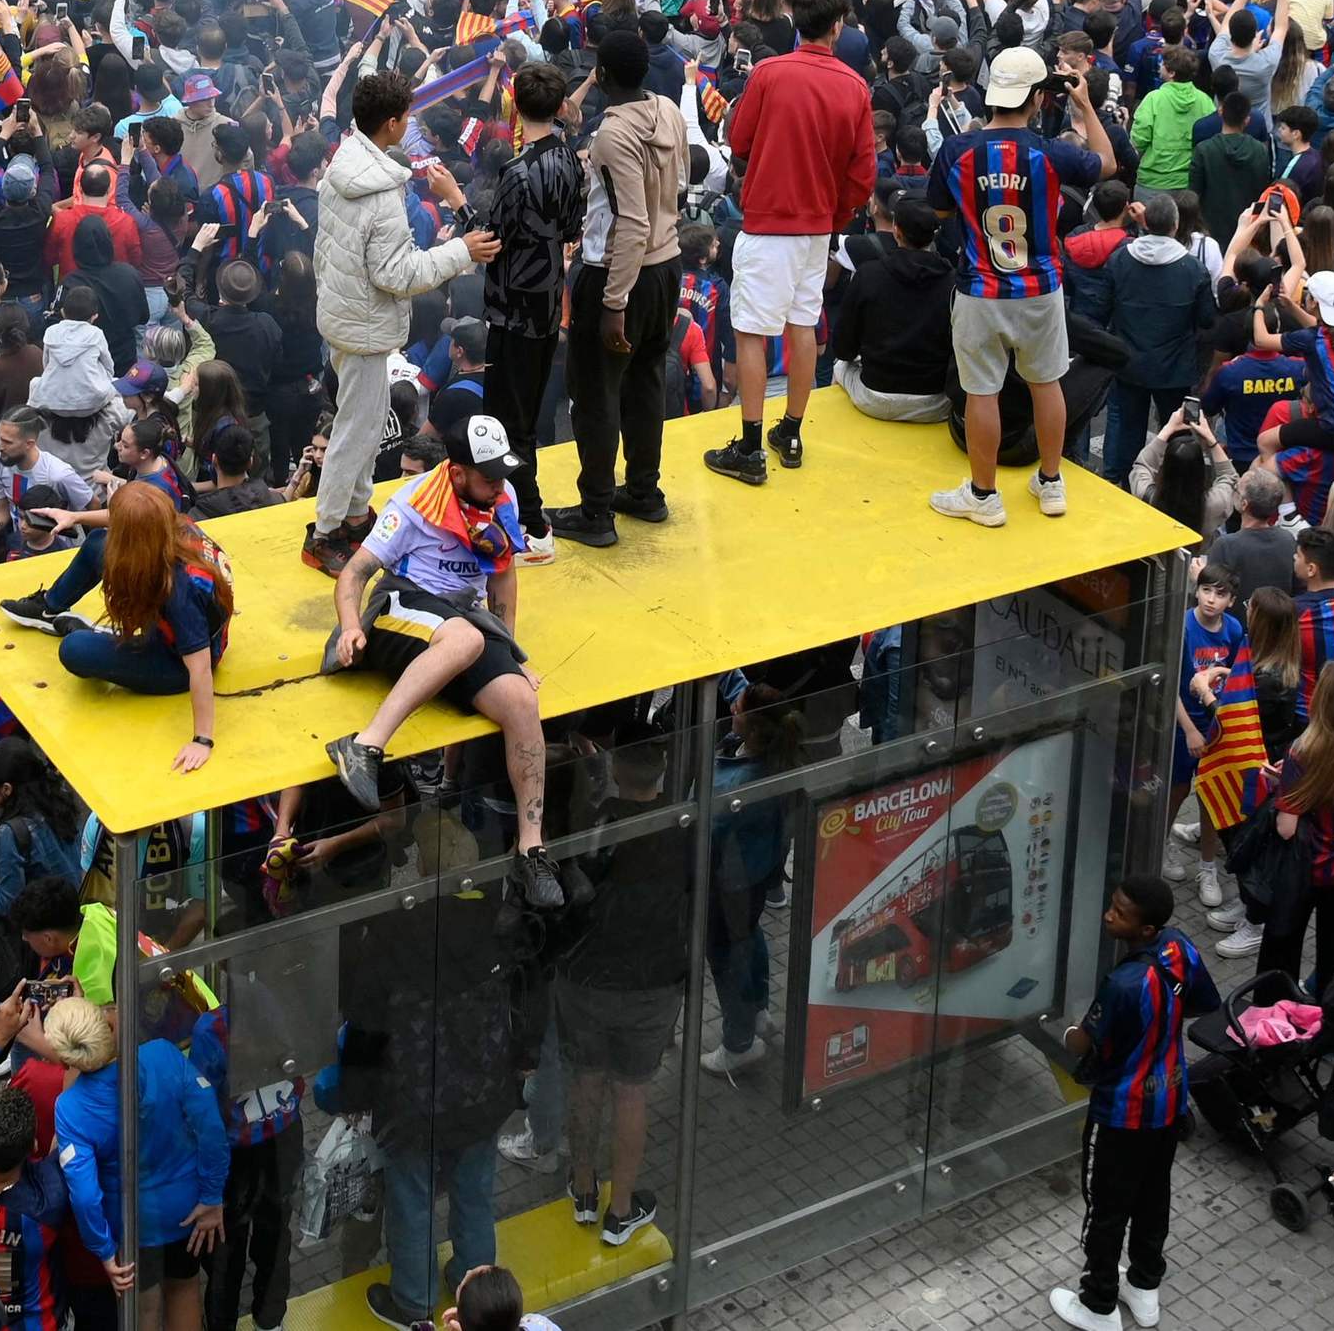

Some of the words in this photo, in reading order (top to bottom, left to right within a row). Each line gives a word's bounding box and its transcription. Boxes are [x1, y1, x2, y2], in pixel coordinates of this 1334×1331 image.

[977, 172, 1028, 192] PEDRI
[981, 204, 1029, 273] 8
[1243, 377, 1295, 395] BARÇA
[854, 774, 955, 822] BARCELONA
[875, 813, 901, 833] City
[901, 805, 933, 824] Tour
